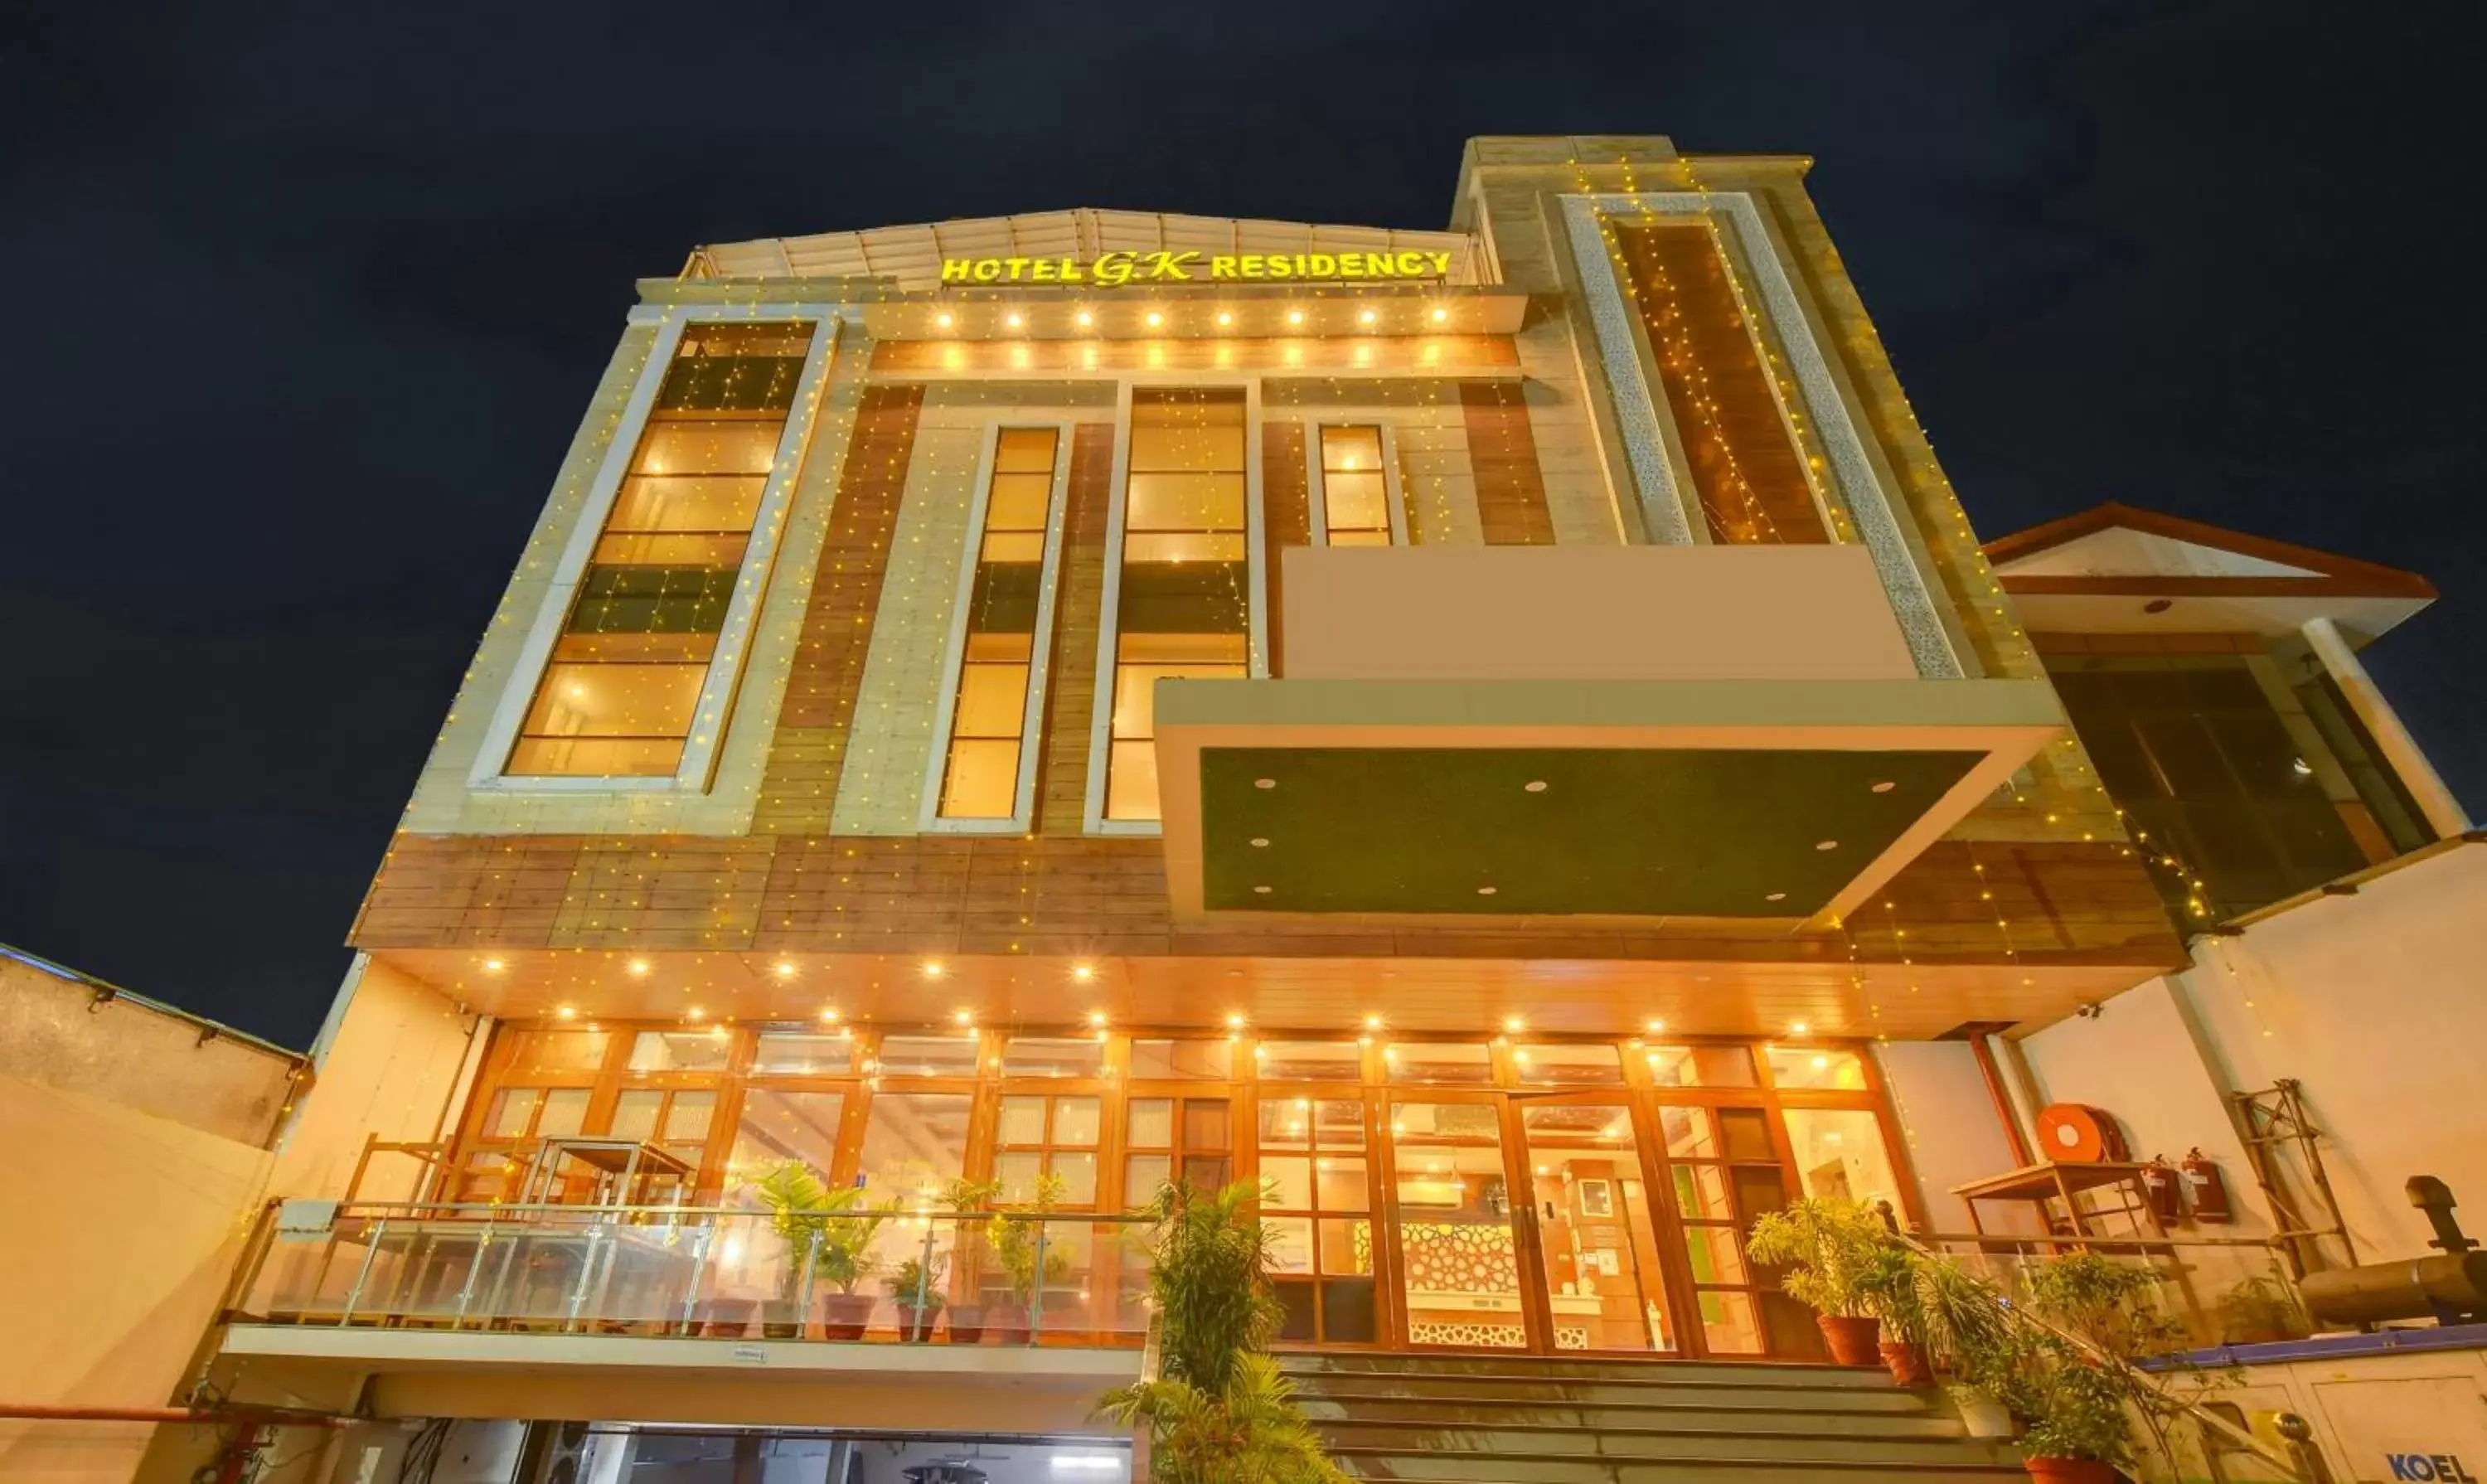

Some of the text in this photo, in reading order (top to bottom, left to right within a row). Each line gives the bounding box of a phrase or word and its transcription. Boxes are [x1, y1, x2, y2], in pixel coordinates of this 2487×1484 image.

[941, 257, 1084, 282] HOTEL
[1211, 251, 1451, 279] RESIDENCY
[2385, 1452, 2478, 1483] KOEL
